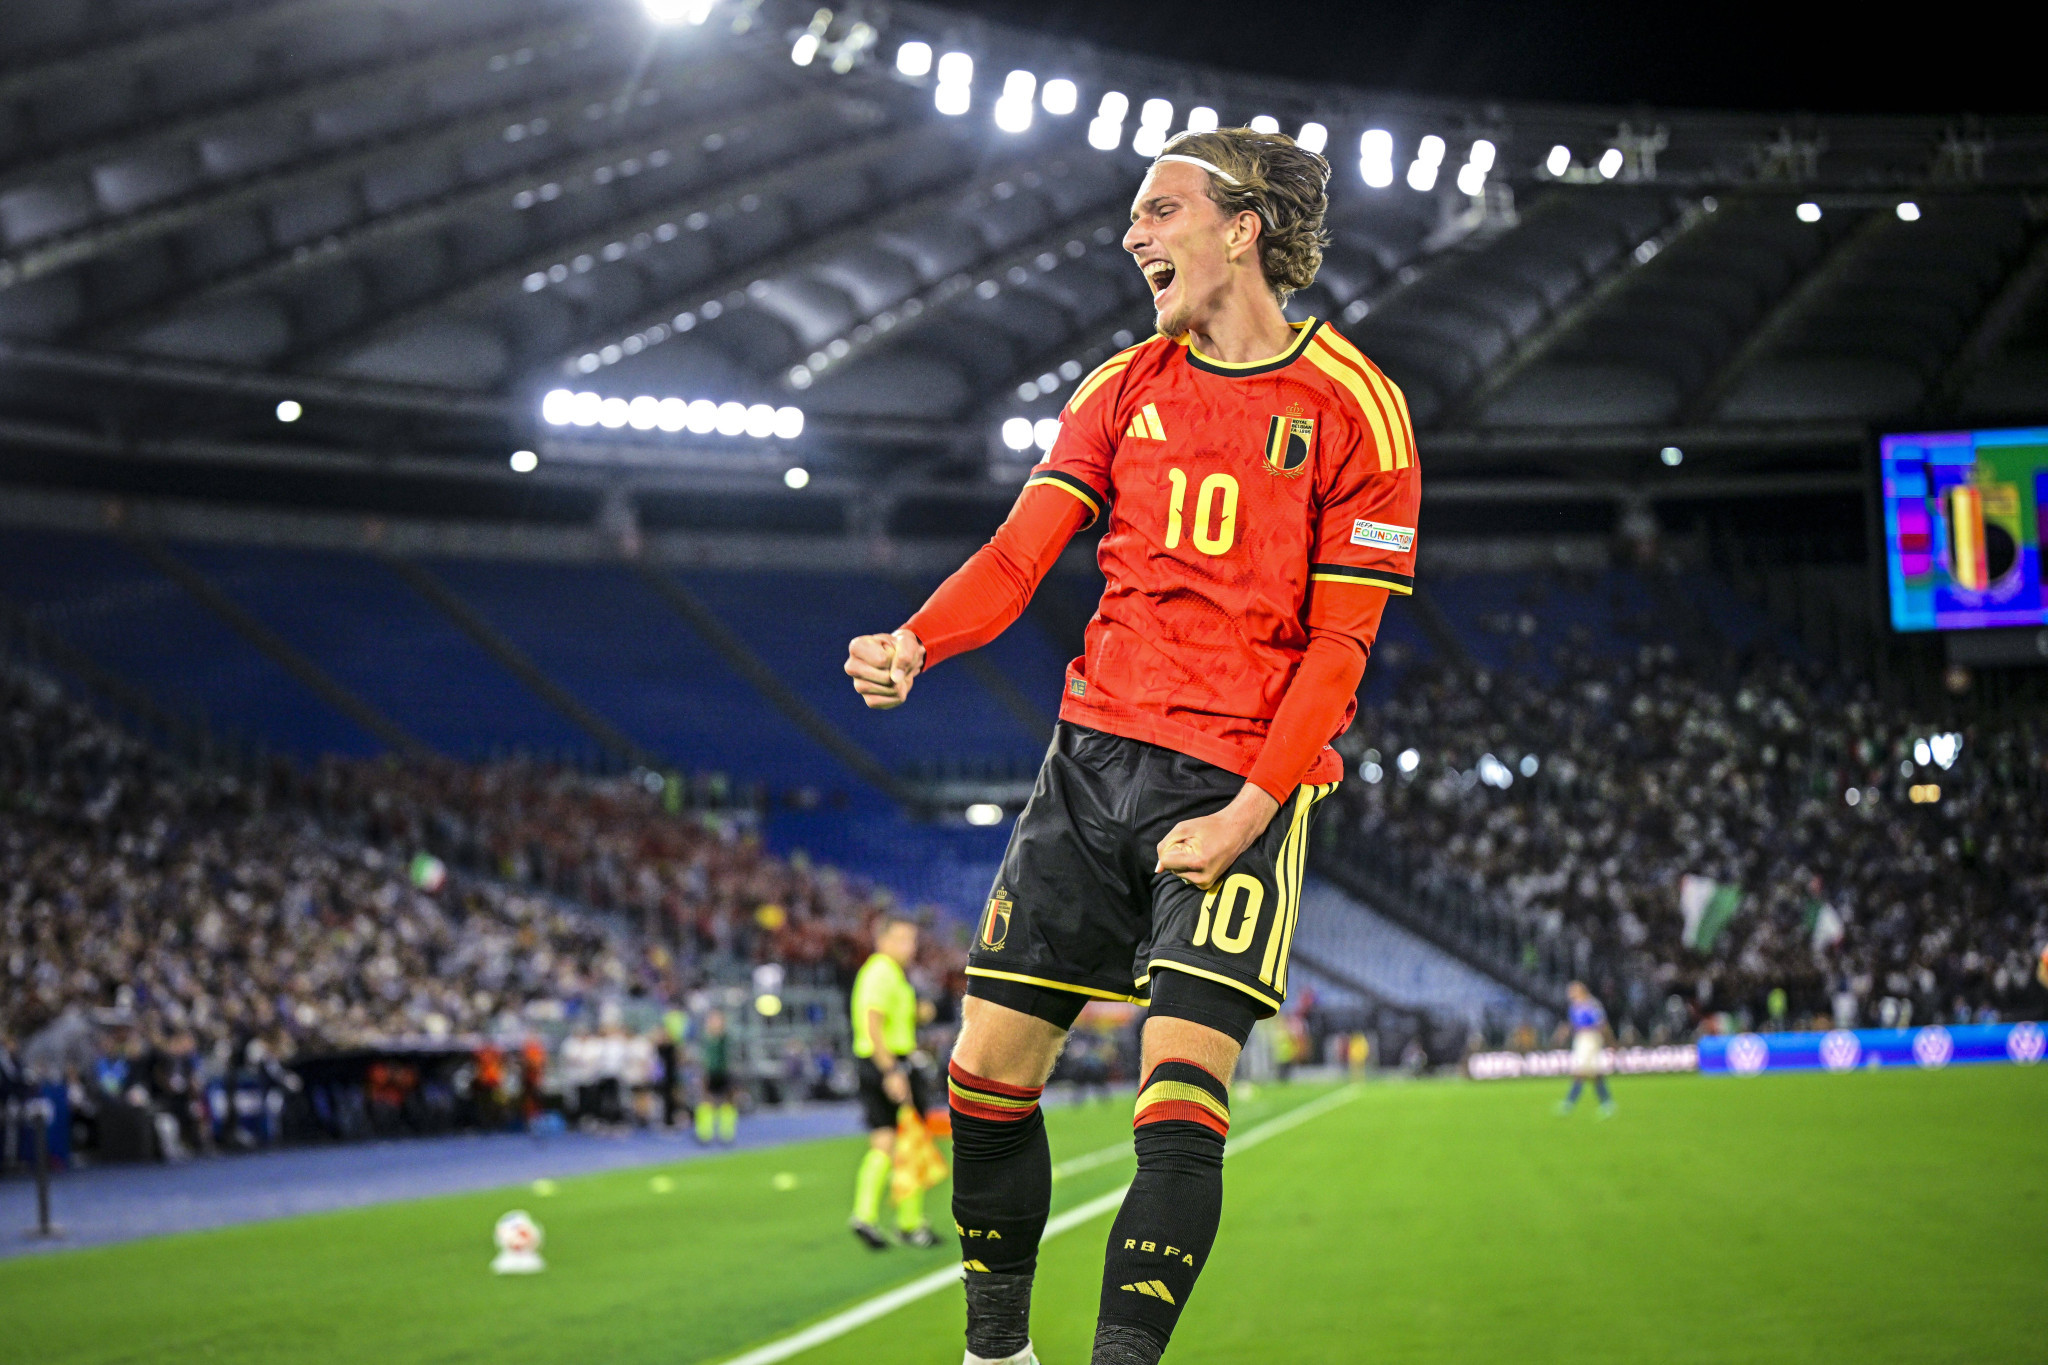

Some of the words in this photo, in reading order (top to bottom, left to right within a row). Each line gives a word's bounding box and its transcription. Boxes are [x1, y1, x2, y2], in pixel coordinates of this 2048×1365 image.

[1165, 467, 1240, 556] 10
[1192, 873, 1265, 954] 10
[1124, 1238, 1193, 1267] RBFA
